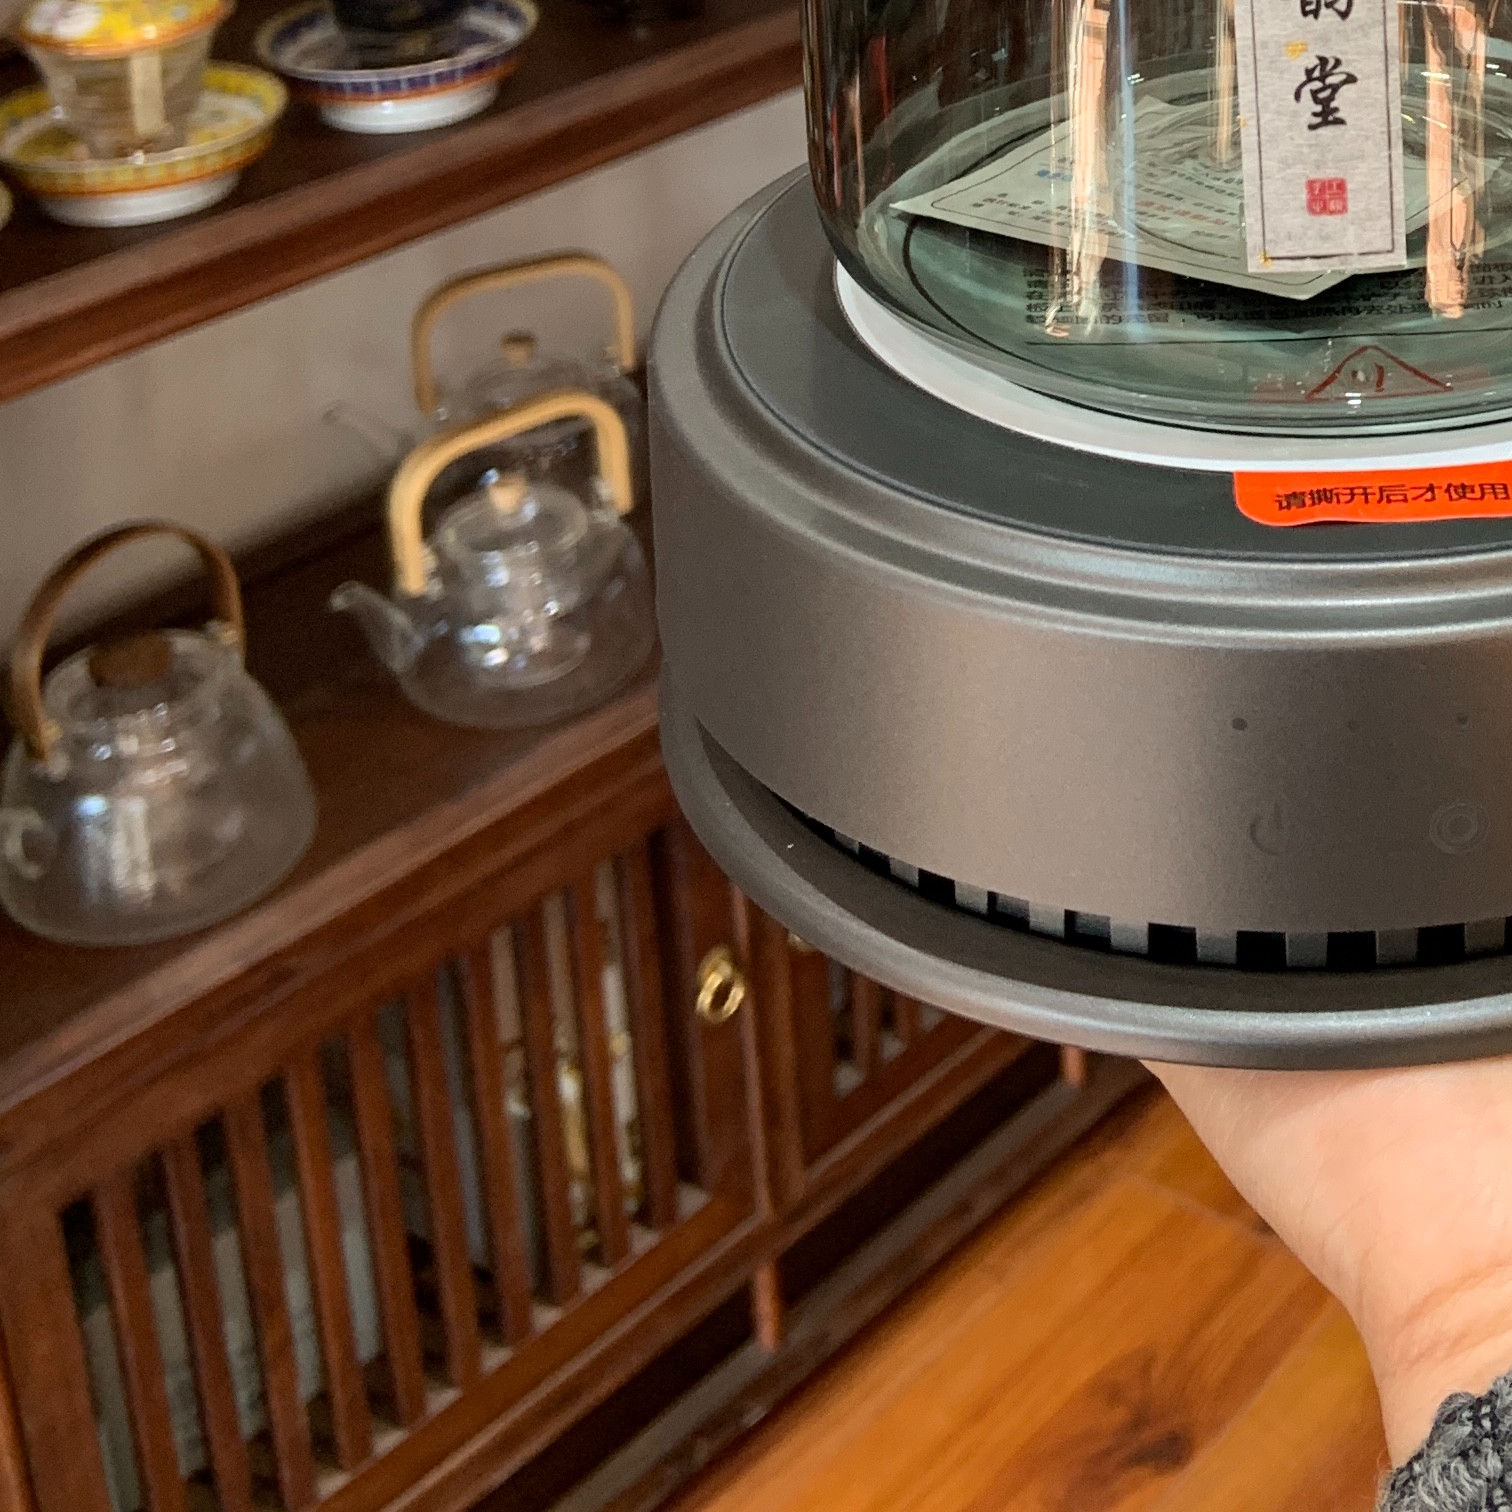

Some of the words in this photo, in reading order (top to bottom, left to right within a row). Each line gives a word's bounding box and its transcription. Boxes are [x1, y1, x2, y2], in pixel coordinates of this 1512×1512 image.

[1275, 482, 1512, 511] 请撕开后才使用
